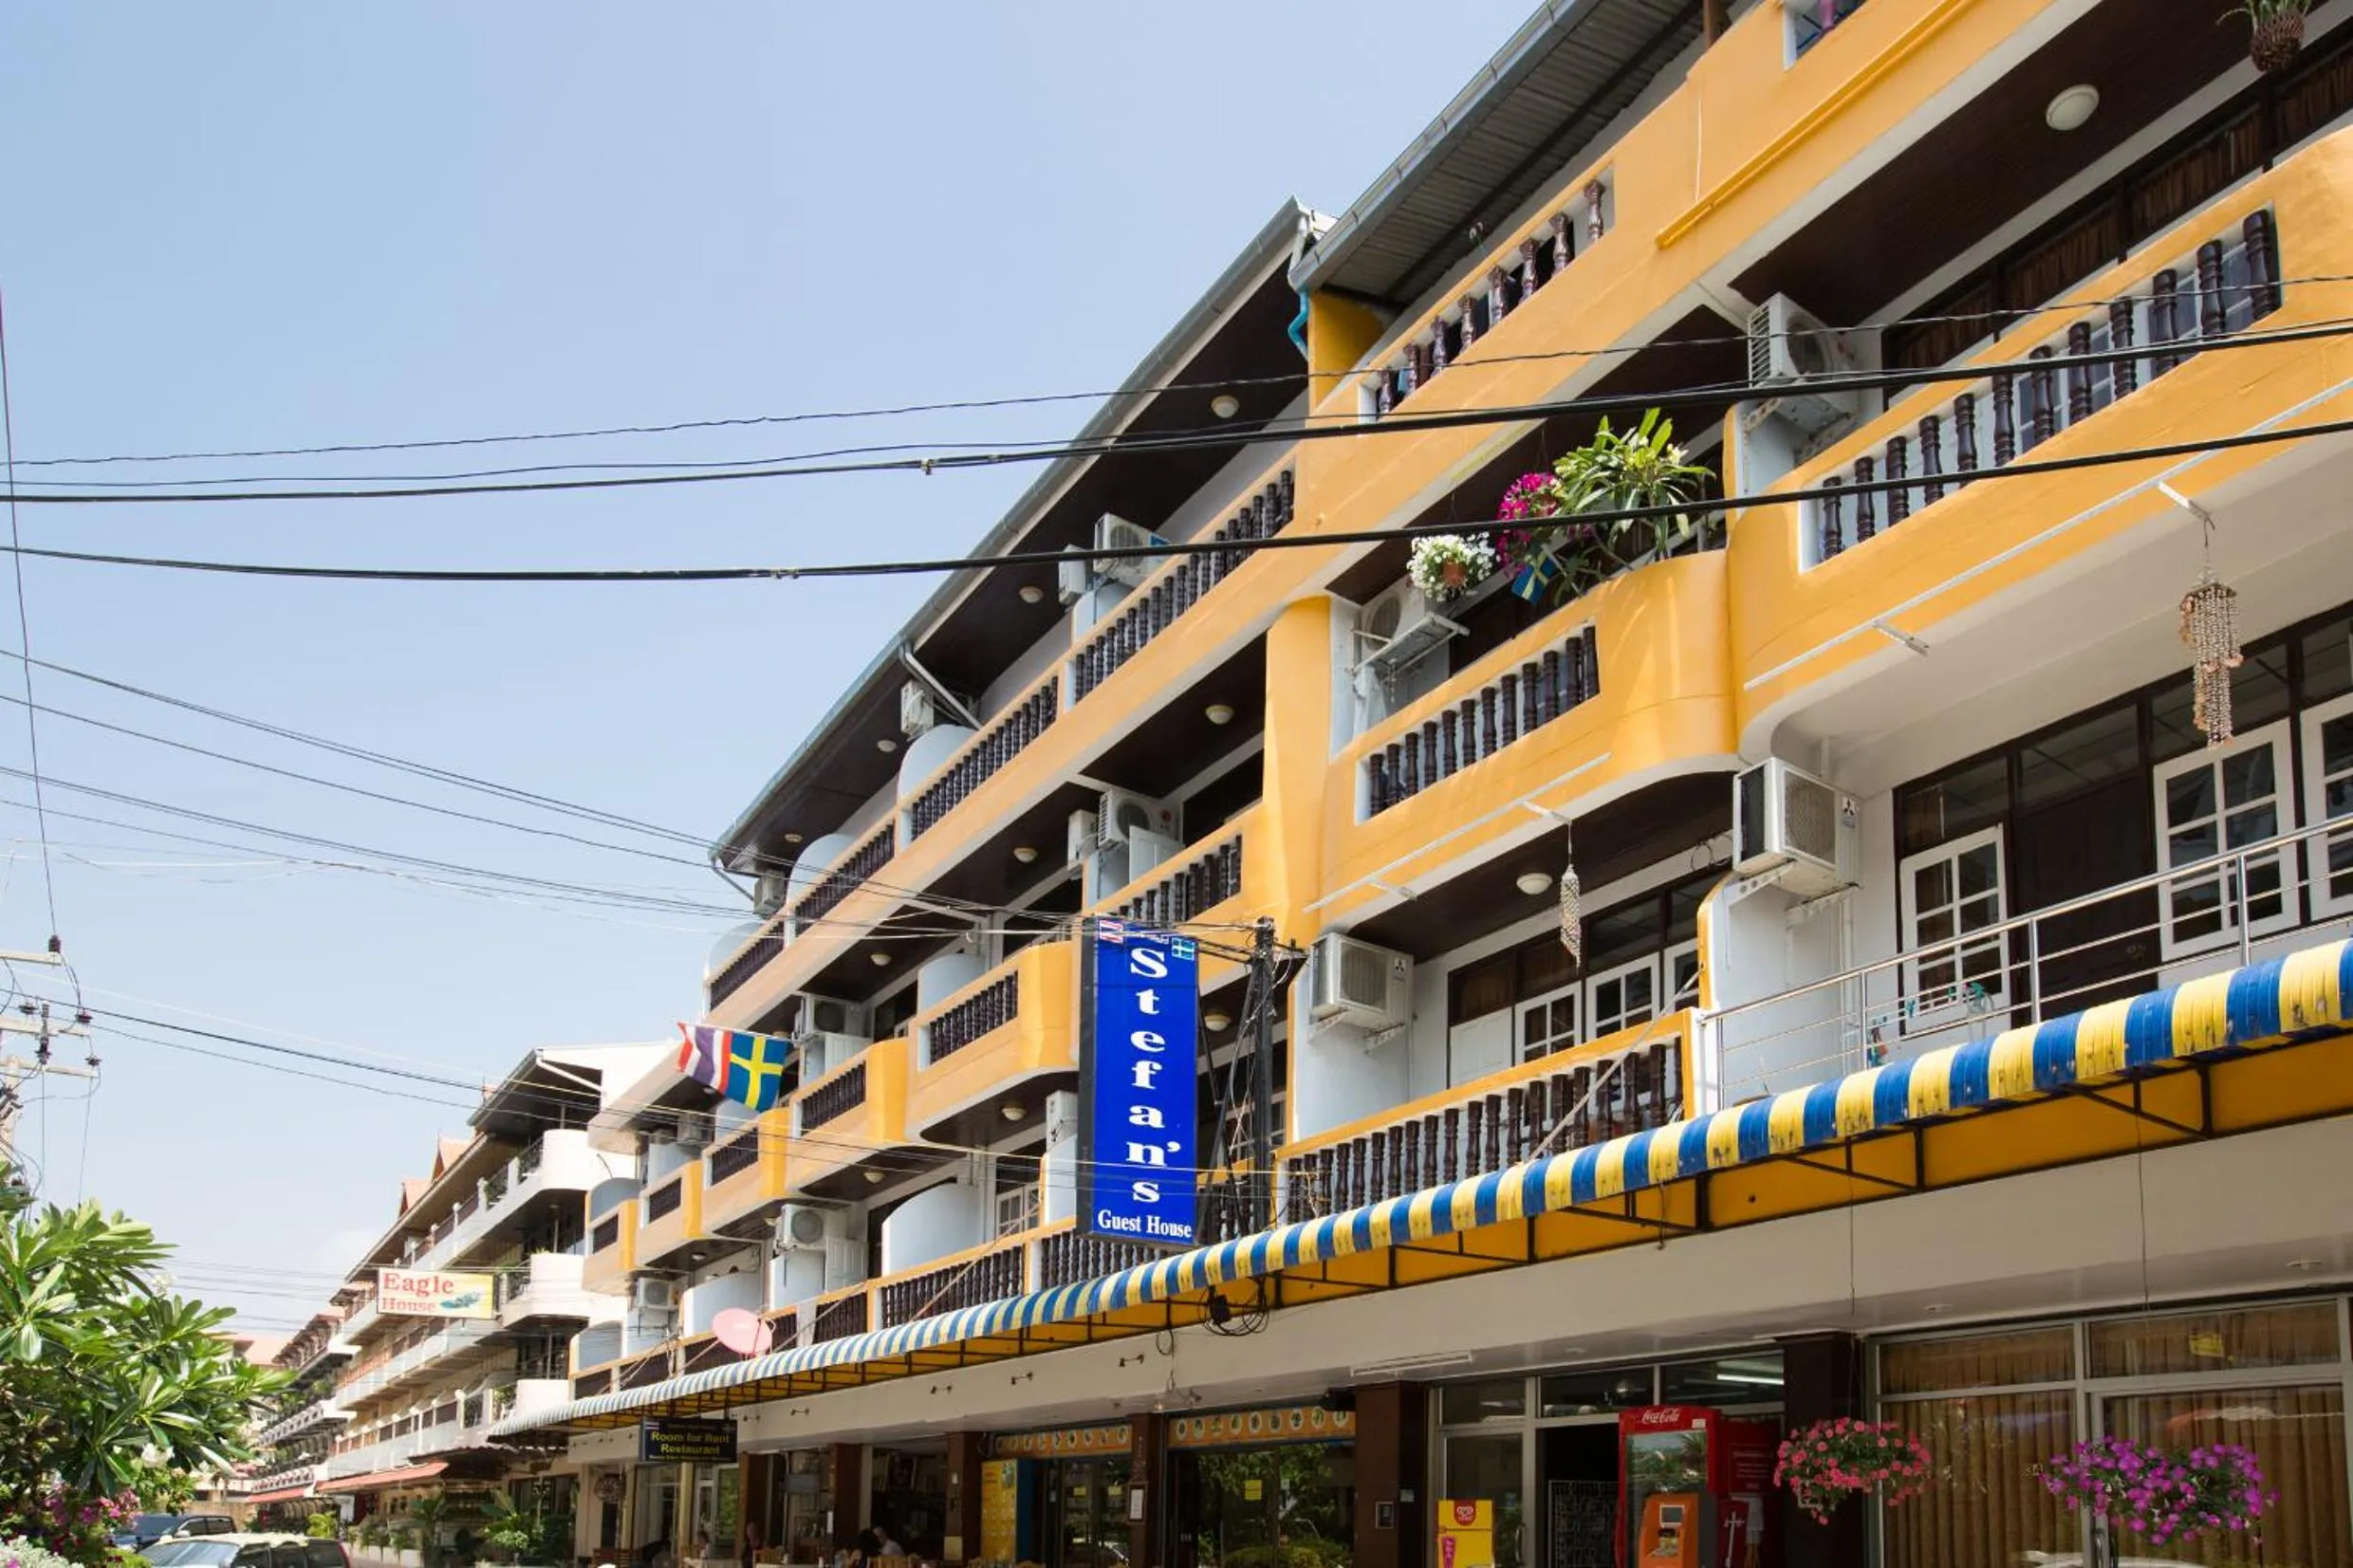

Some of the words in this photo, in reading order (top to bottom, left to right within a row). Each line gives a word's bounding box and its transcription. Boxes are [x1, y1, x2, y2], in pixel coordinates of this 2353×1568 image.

[1126, 948, 1181, 1203] Stefan's
[1098, 1209, 1141, 1232] Guest
[1146, 1215, 1192, 1238] House
[383, 1273, 454, 1297] Eagle
[382, 1298, 435, 1312] House
[652, 1431, 684, 1442] Room
[687, 1432, 702, 1442] for
[705, 1434, 730, 1443] Rent
[661, 1444, 720, 1454] Restaurant
